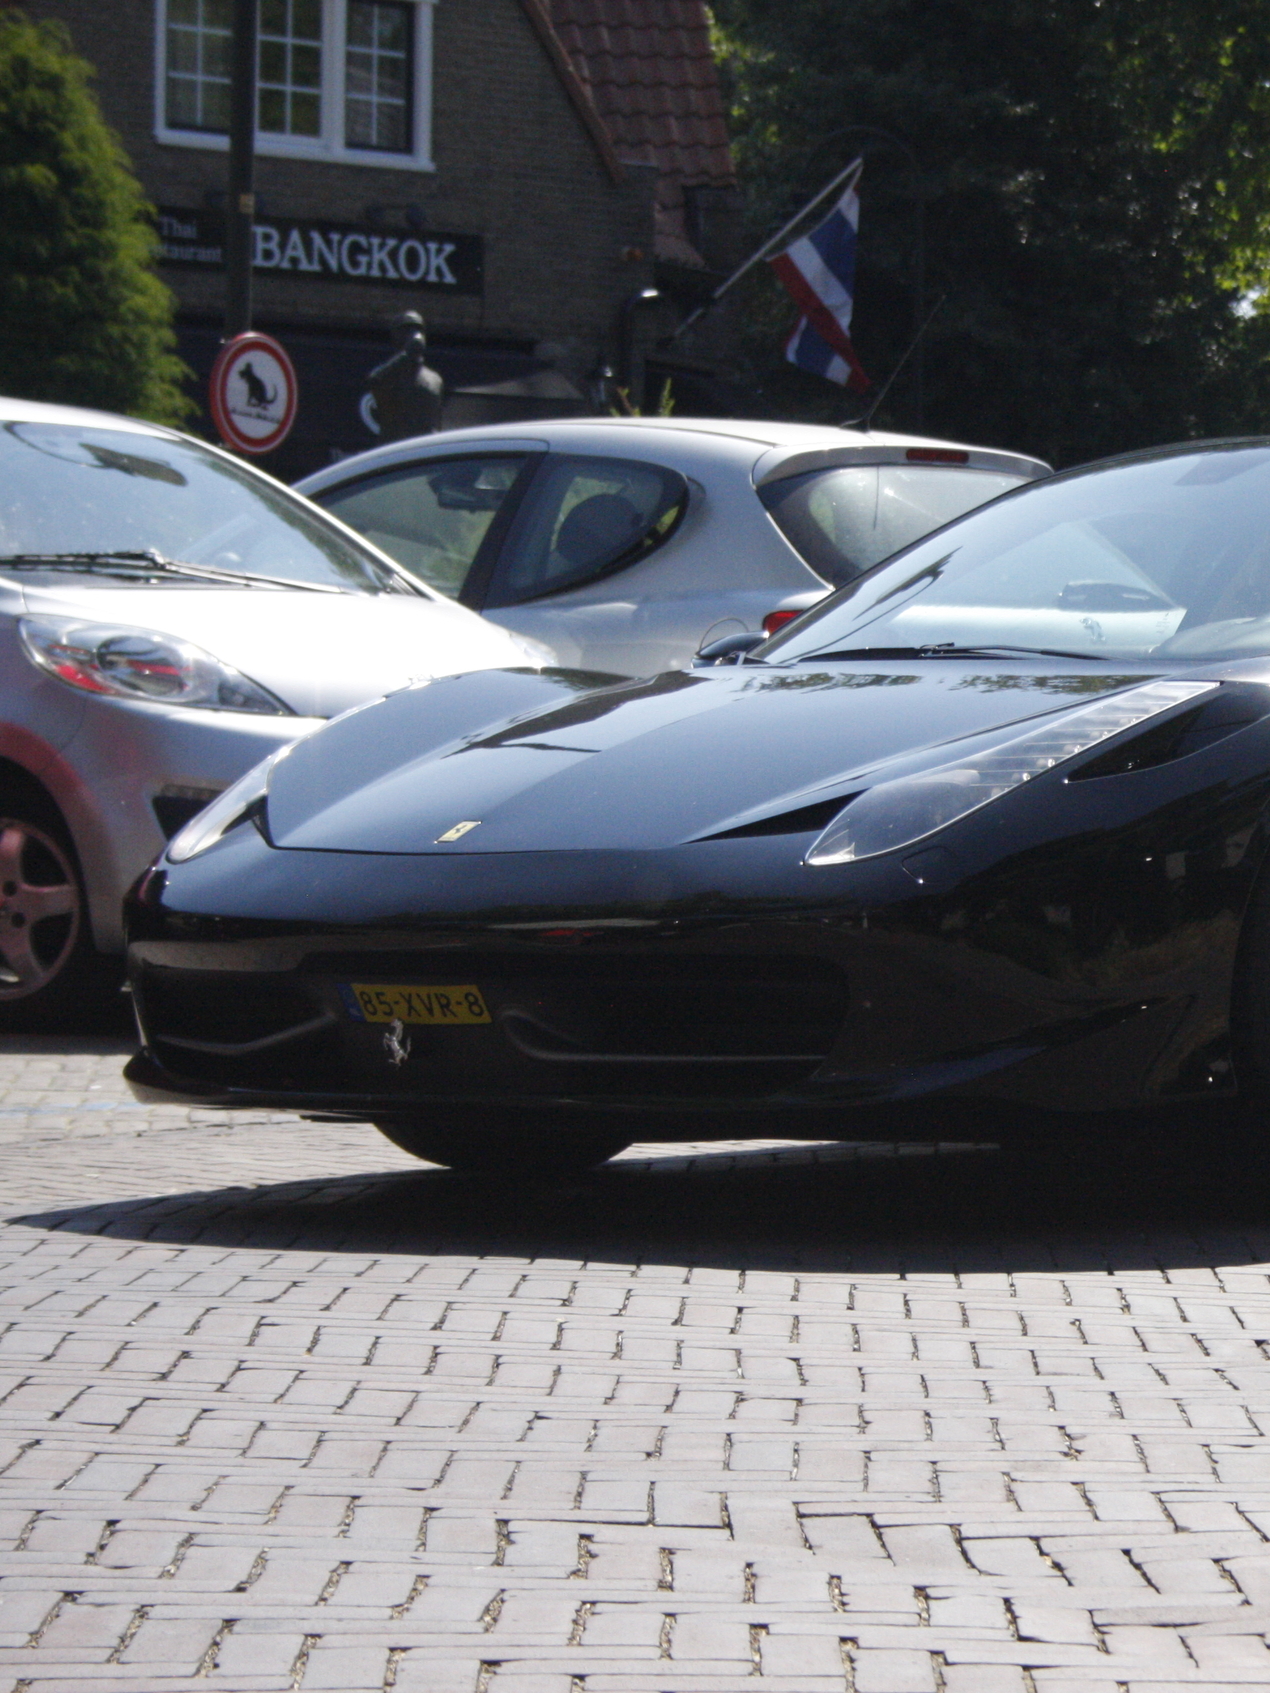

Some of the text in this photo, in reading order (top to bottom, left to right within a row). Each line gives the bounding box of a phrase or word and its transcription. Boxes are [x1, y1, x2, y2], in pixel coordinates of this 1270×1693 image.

[158, 216, 197, 238] Thai
[252, 225, 457, 284] BANGKOK
[359, 991, 485, 1017] 85-XVR-8
